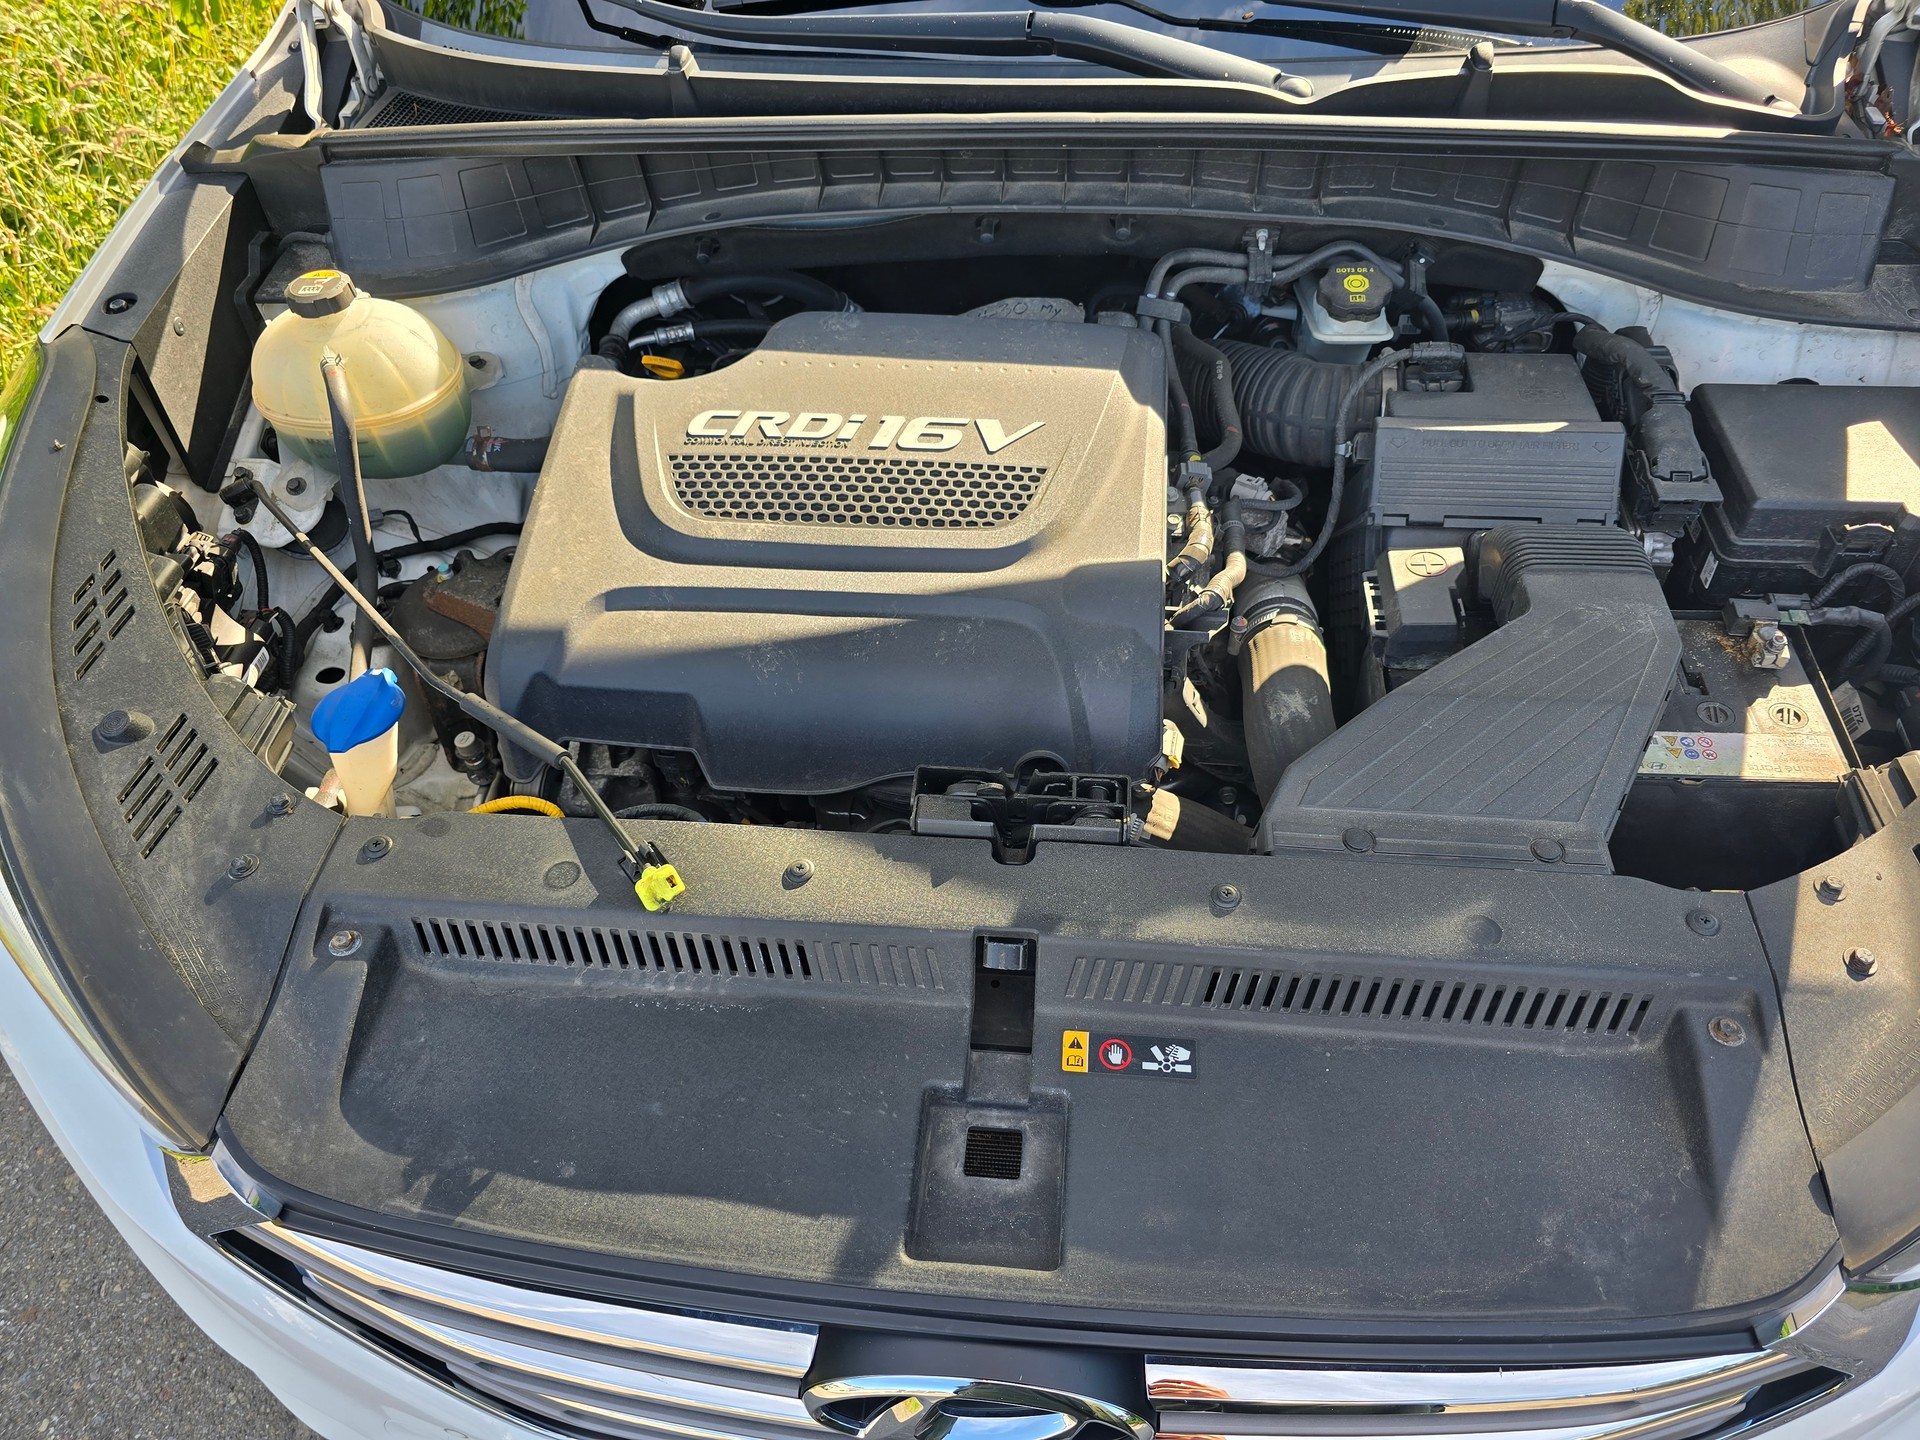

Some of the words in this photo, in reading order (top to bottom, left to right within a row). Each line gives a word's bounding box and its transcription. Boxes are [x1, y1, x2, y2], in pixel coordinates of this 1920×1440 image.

[685, 409, 868, 442] CRDi
[868, 415, 1046, 455] 16V
[684, 436, 729, 446] COMMON
[731, 437, 754, 447] RAIL
[756, 438, 794, 449] DIRECT
[796, 438, 849, 450] INJECTION
[1422, 437, 1447, 448] PULL
[1449, 438, 1469, 449] OUT
[1472, 439, 1485, 449] TO
[1852, 704, 1864, 725] D72
[1747, 763, 1782, 773] Parts
